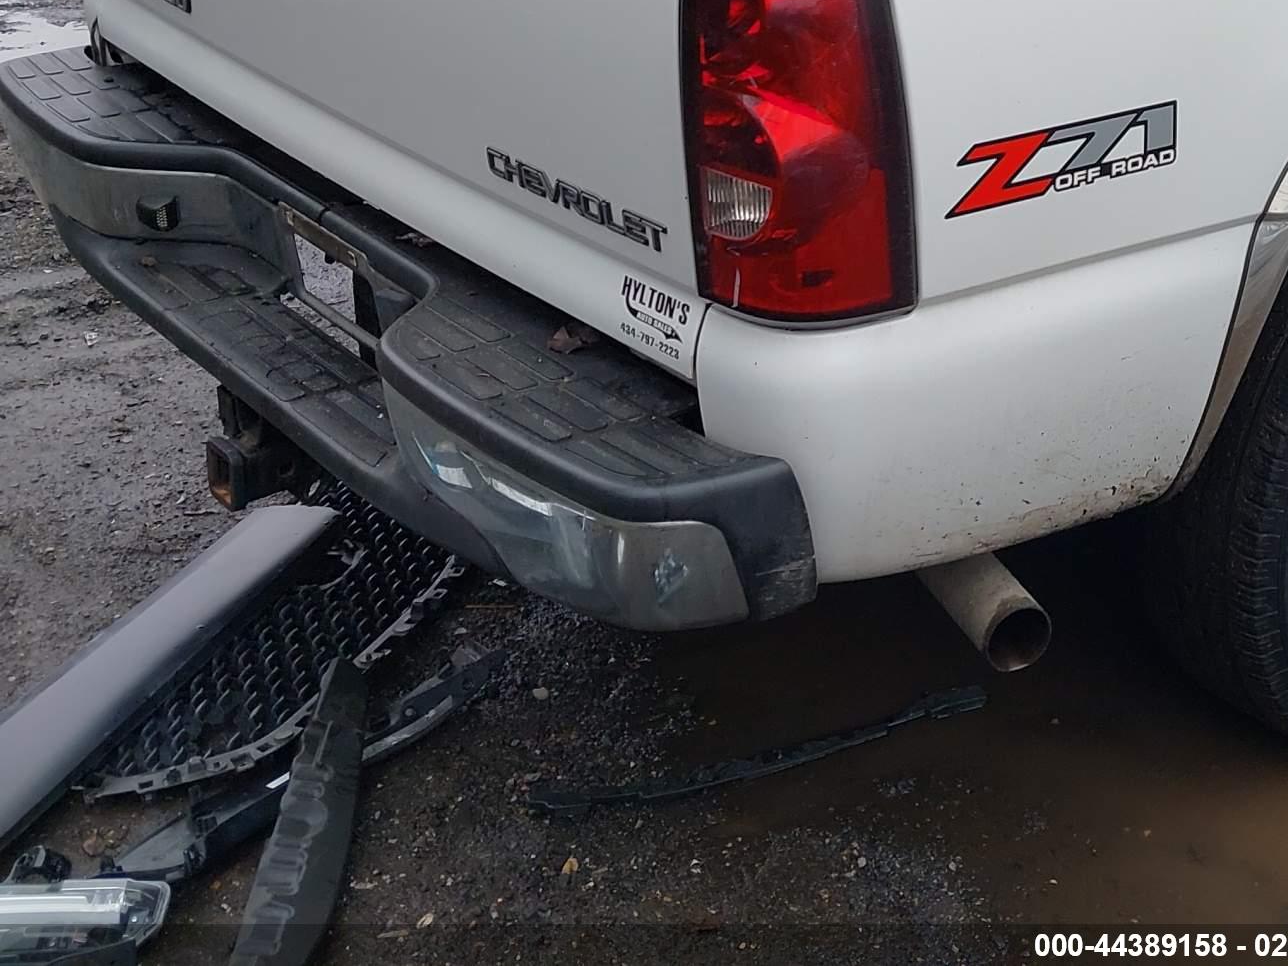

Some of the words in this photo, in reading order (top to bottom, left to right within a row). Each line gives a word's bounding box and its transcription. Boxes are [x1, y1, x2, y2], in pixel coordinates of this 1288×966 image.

[945, 100, 1177, 219] Z71
[1055, 166, 1101, 191] OFF
[1111, 149, 1175, 177] ROAD
[486, 147, 668, 253] CHEVROLET
[621, 275, 690, 325] HYLTON'S
